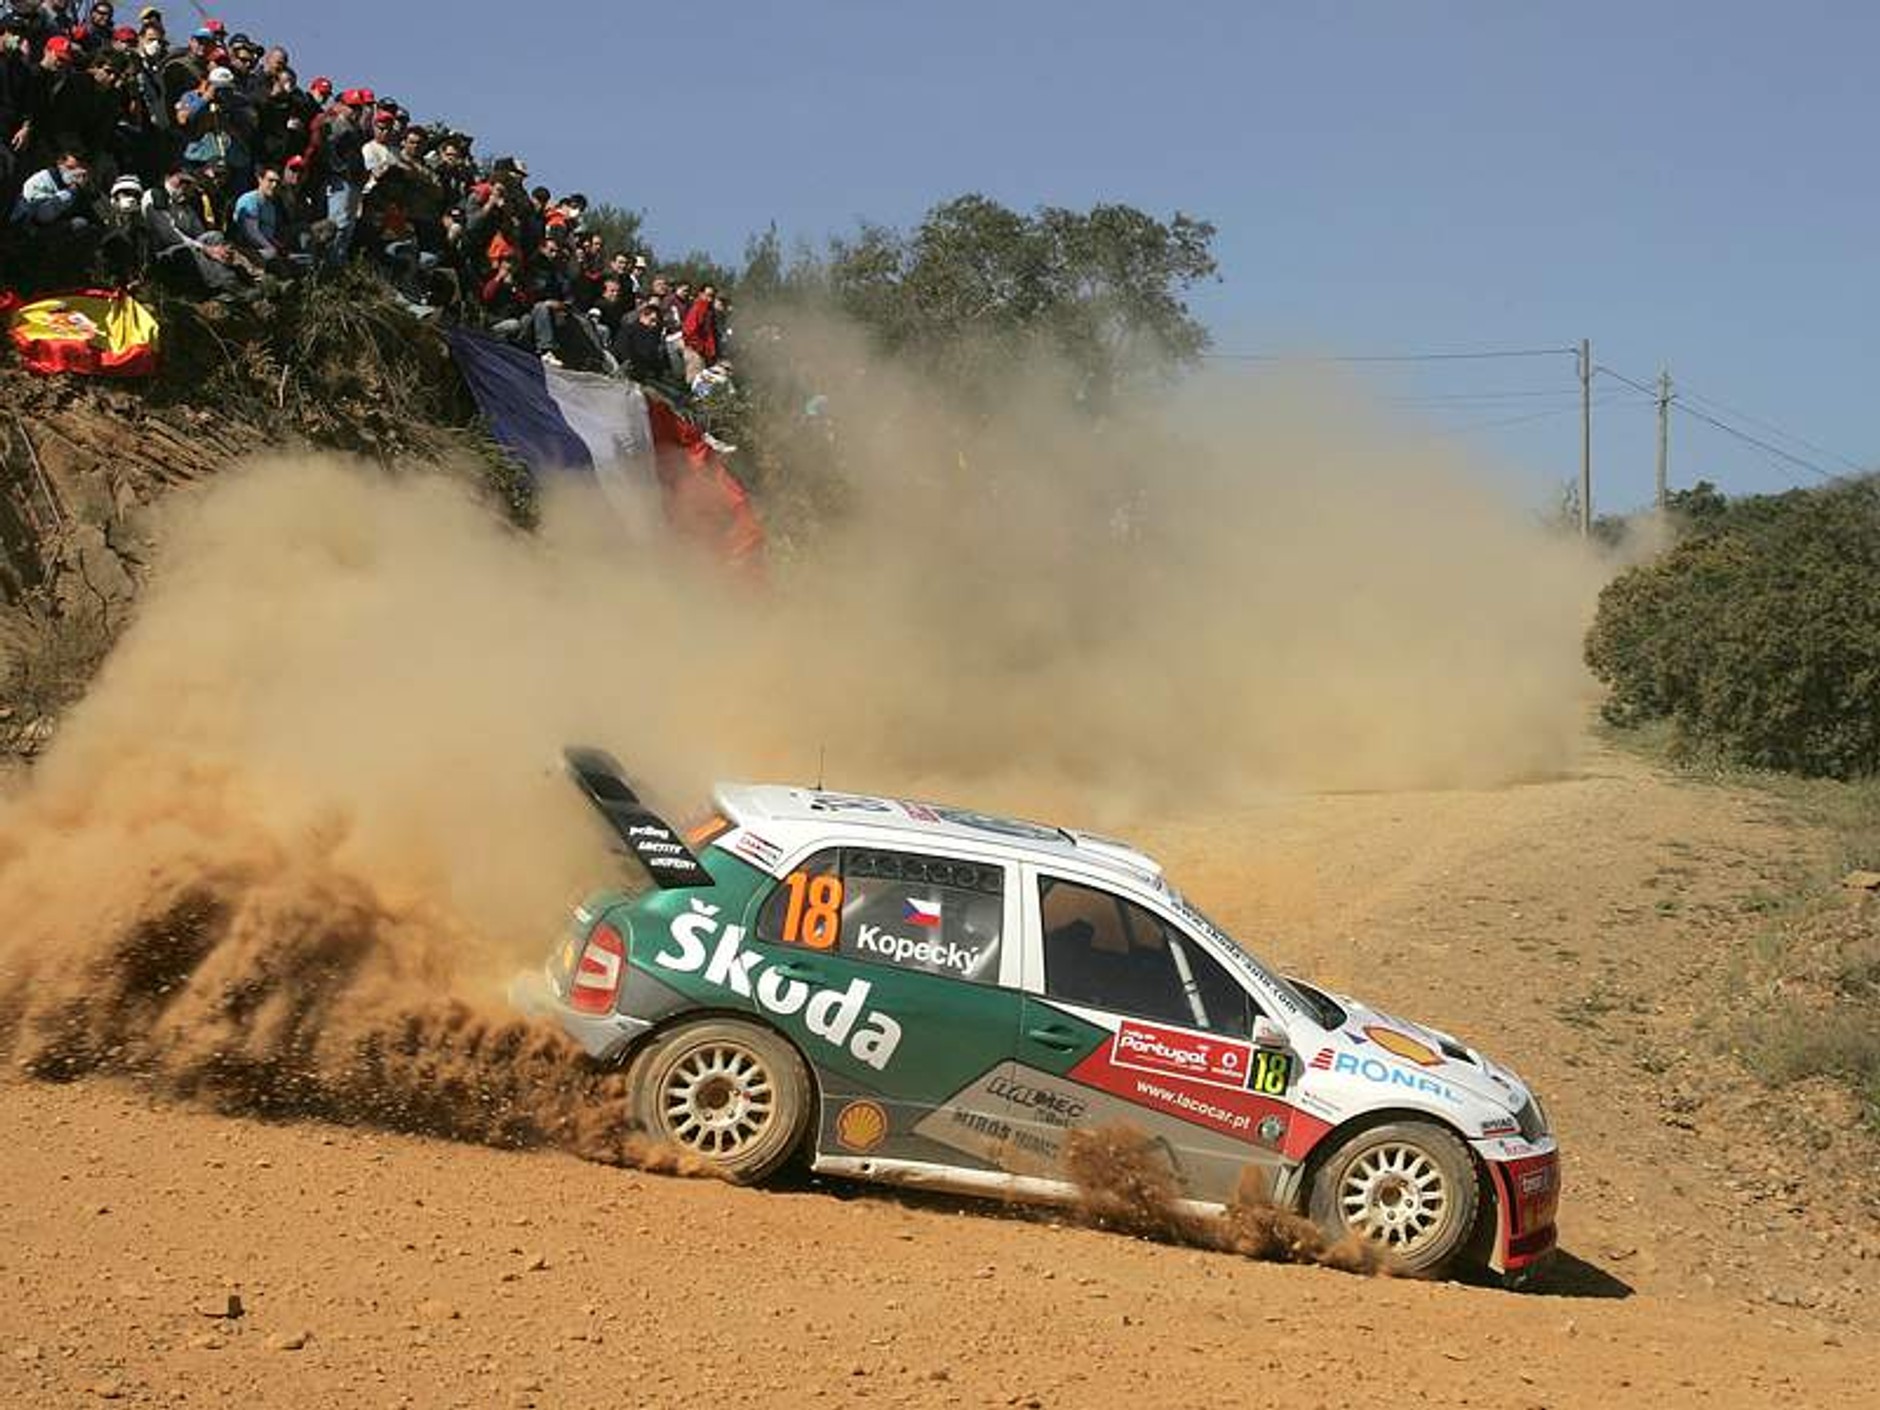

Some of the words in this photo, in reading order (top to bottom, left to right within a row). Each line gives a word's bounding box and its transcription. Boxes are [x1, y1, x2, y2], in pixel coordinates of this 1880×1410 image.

[781, 871, 843, 948] 18
[856, 924, 980, 974] Kopecký
[653, 897, 902, 1071] Škoda
[1118, 1035, 1210, 1065] Portugal
[1254, 1052, 1287, 1094] 18
[1334, 1052, 1464, 1104] RONAL
